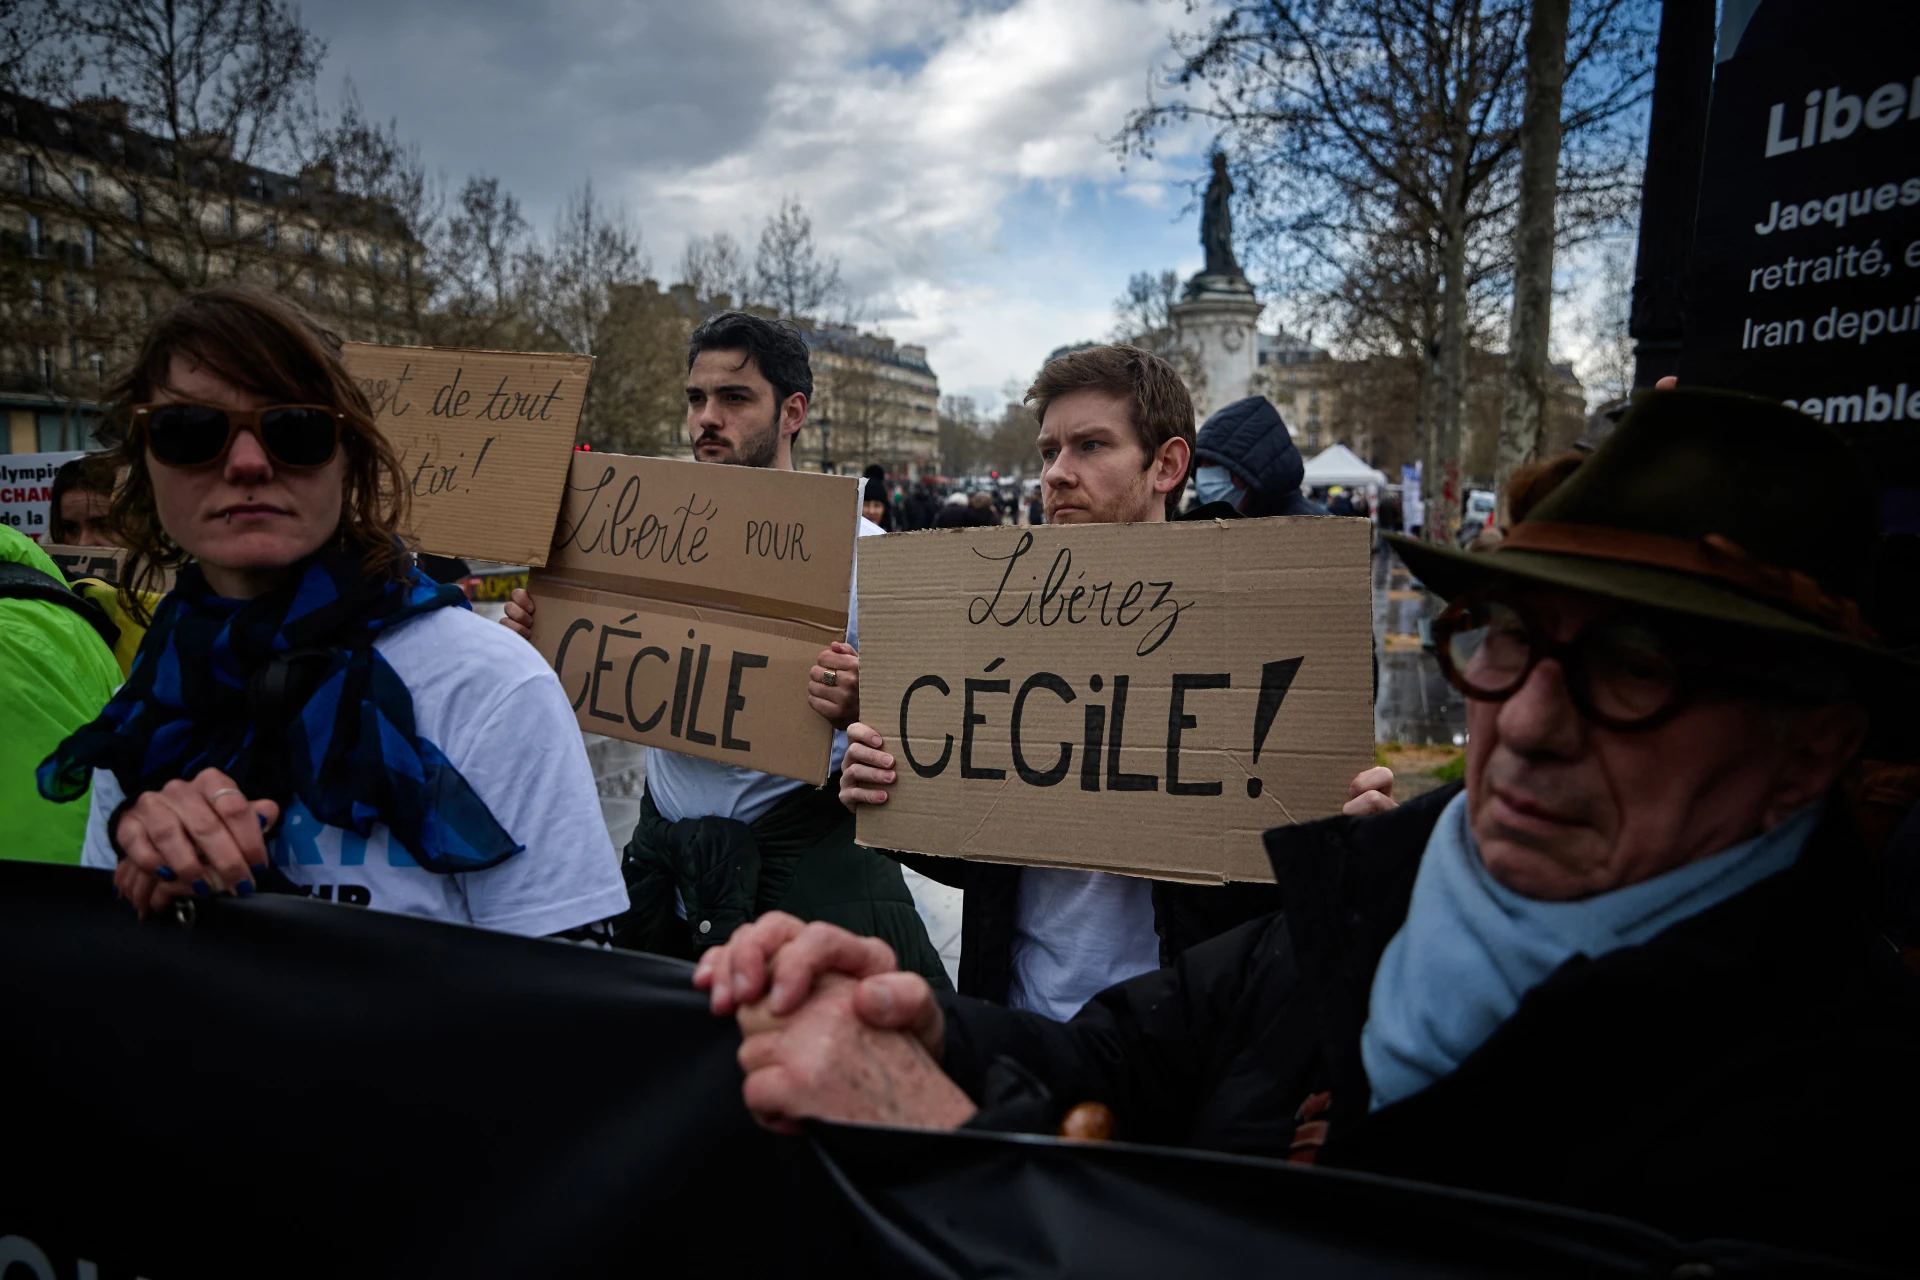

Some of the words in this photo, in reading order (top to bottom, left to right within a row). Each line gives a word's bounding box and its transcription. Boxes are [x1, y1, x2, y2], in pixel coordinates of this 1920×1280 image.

[1748, 238, 1892, 293] retraité,
[1742, 317, 1807, 350] Iran
[426, 367, 471, 418] de
[475, 376, 563, 421] tout
[27, 510, 43, 525] la
[553, 466, 718, 565] Liberté
[745, 520, 811, 562] POUR
[968, 531, 1195, 656] Libérez
